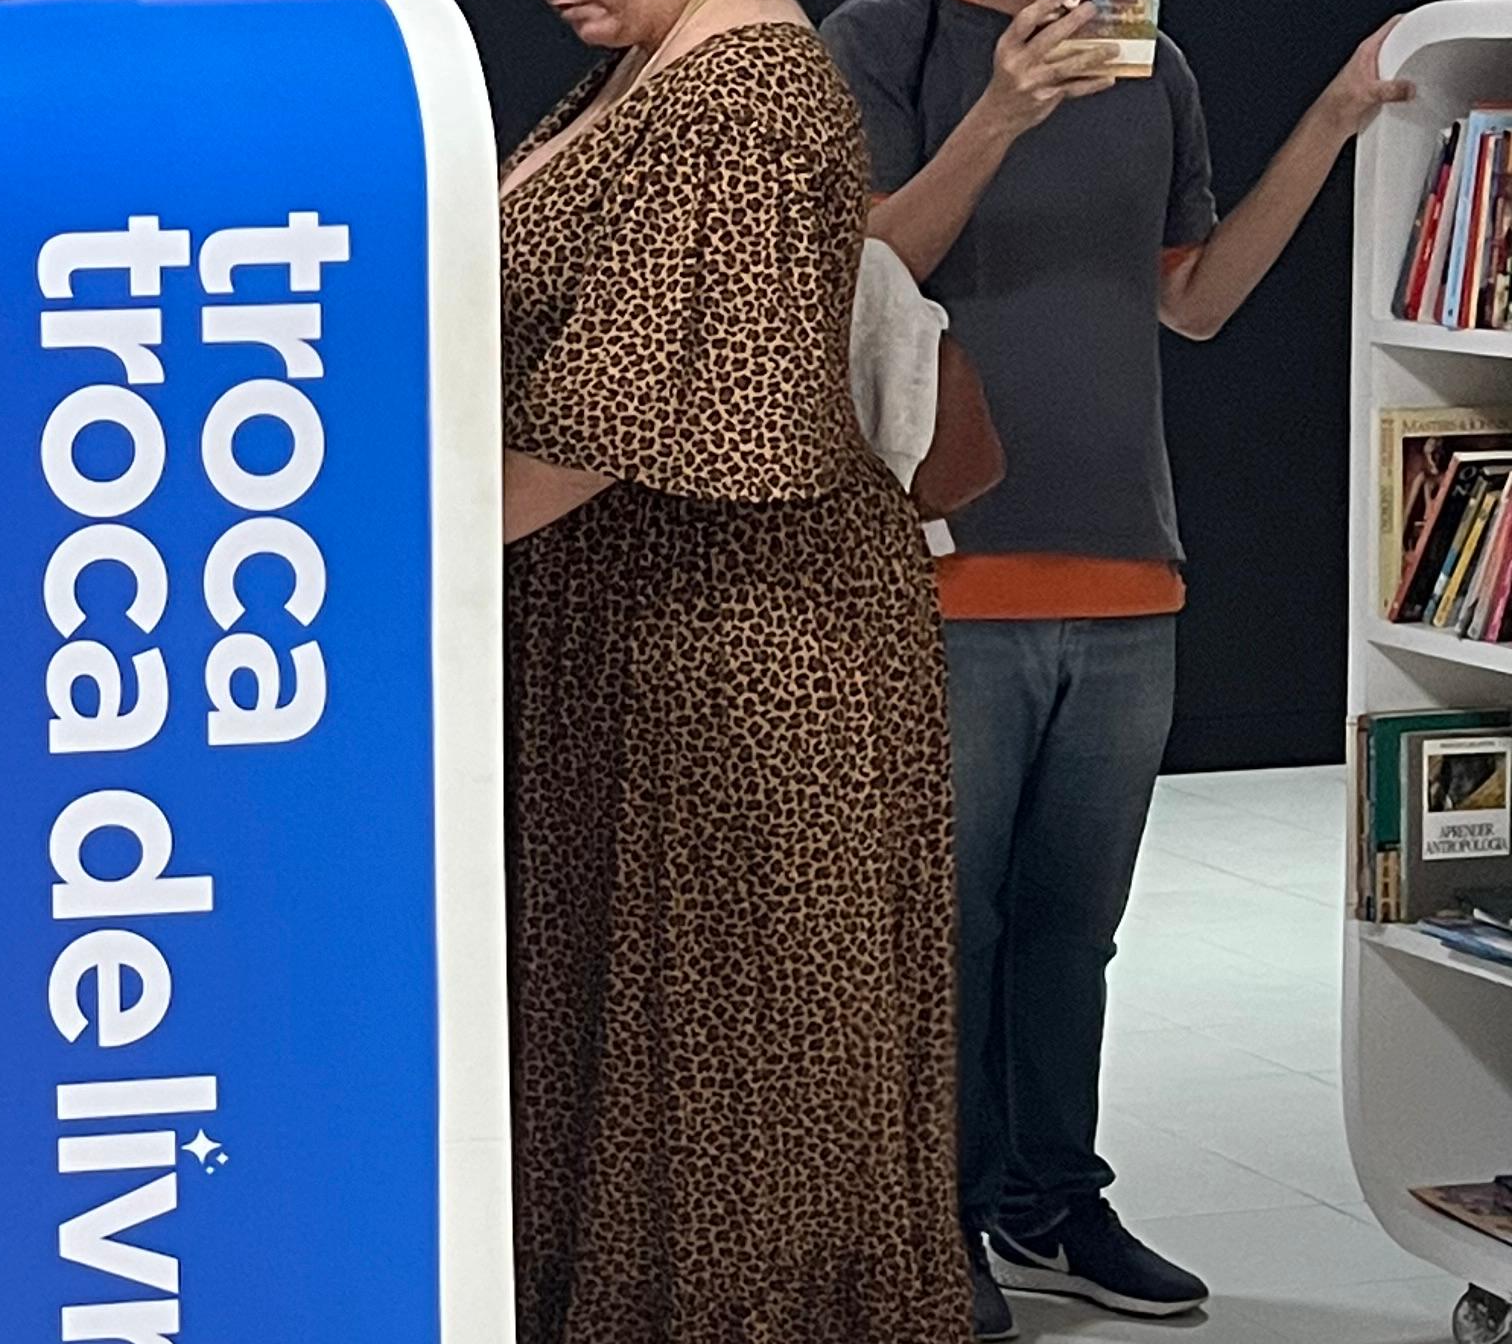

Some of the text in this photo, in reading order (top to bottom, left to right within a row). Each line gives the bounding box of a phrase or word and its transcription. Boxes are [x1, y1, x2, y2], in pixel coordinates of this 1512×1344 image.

[38, 216, 190, 753] troca
[199, 212, 349, 745] troca
[49, 791, 212, 1046] de
